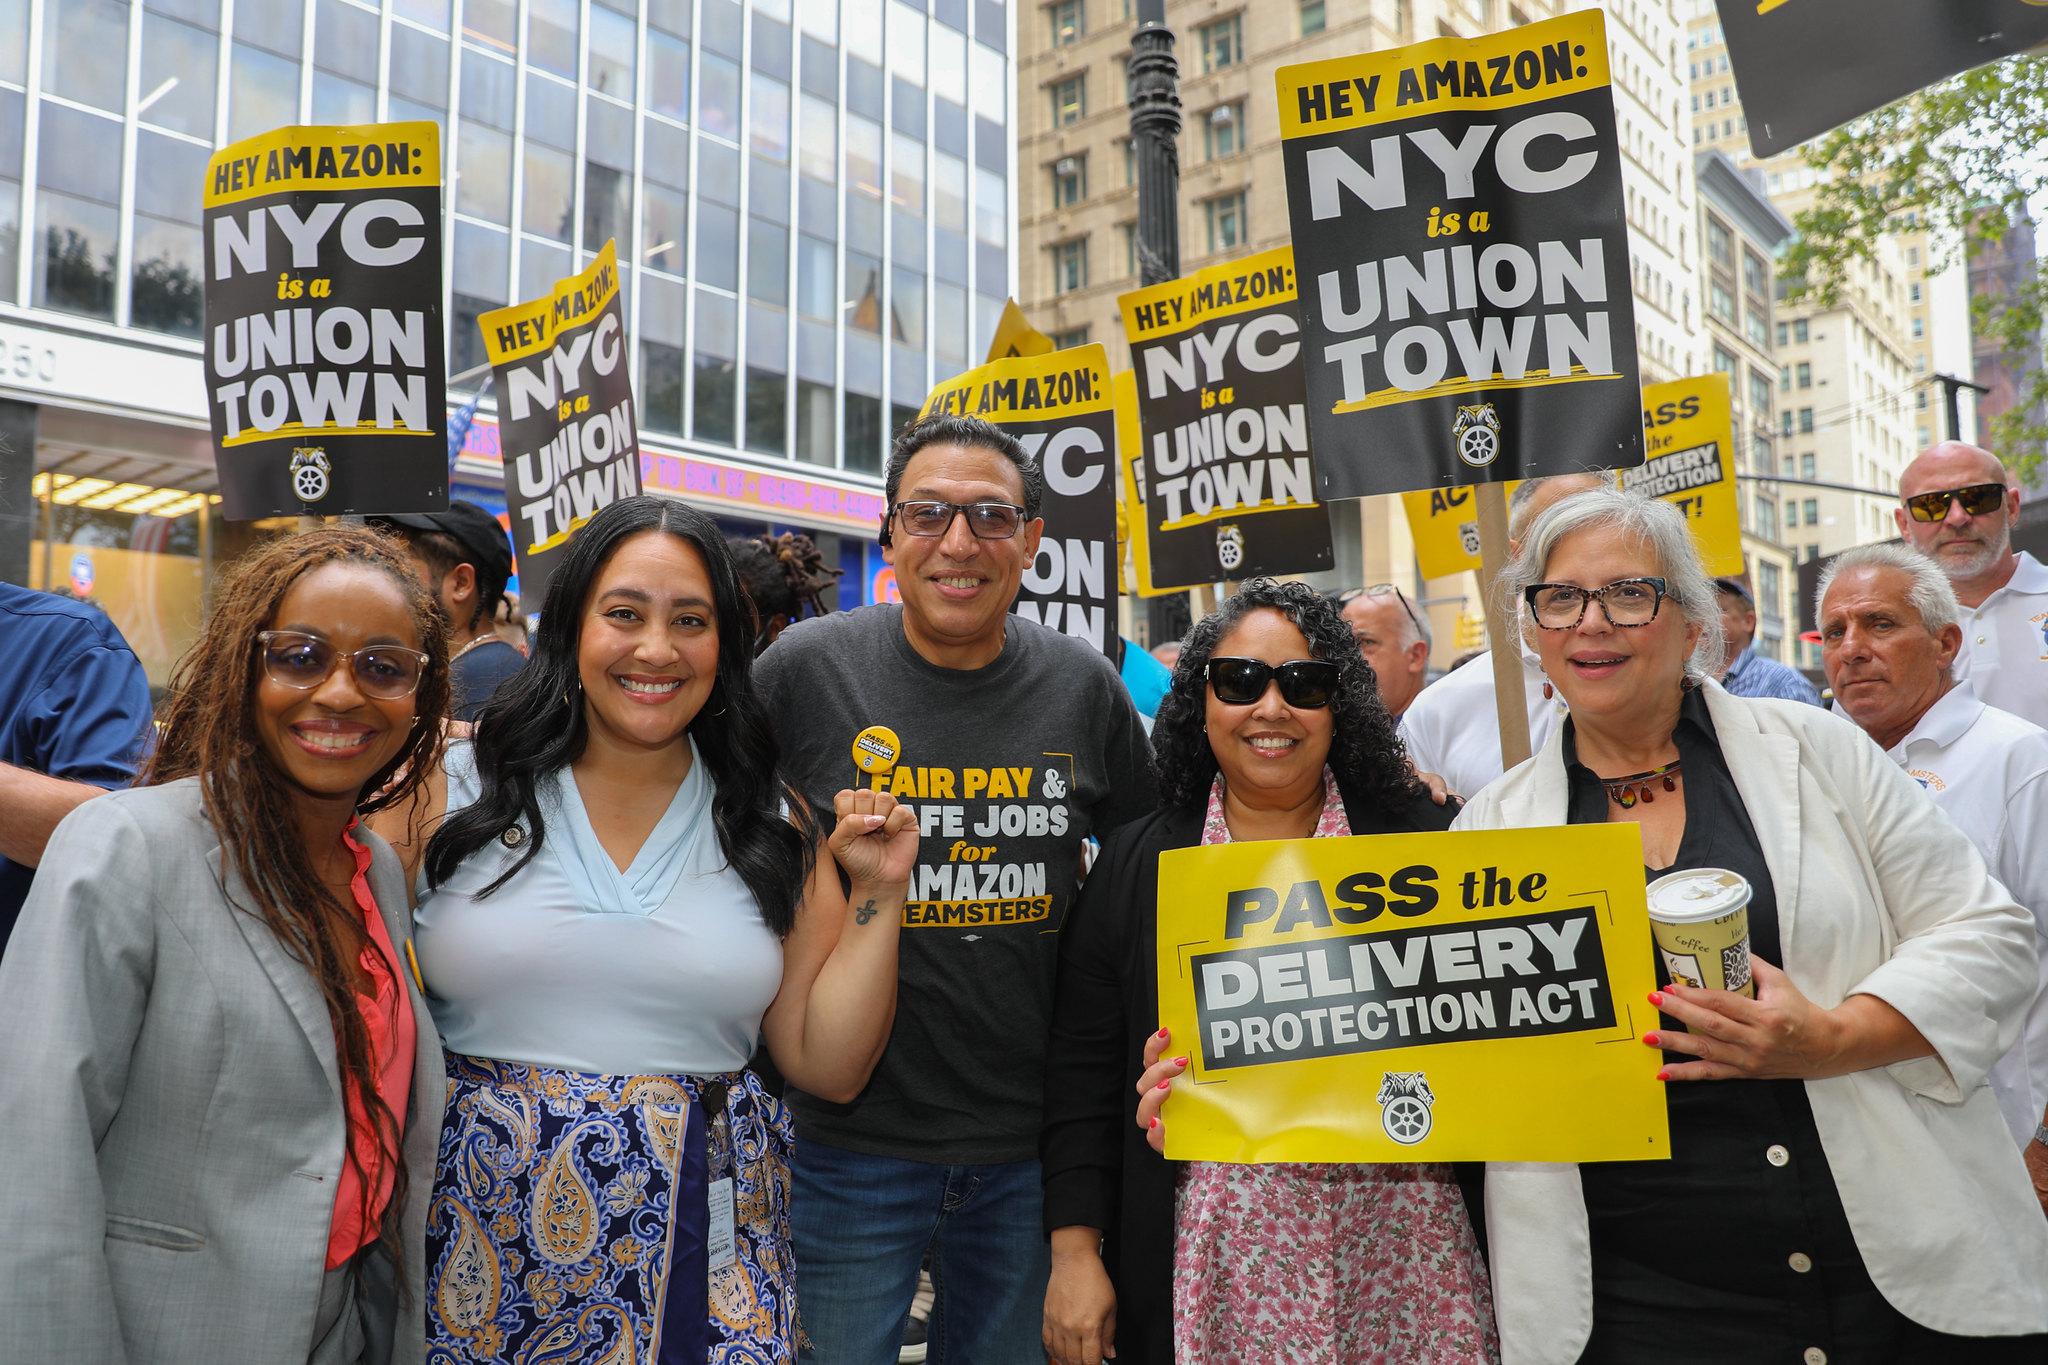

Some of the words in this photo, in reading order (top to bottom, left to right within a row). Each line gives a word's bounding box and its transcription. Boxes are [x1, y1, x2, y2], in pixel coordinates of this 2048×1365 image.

[1297, 75, 1381, 123] HEY
[1396, 40, 1588, 107] AMAZON:
[214, 154, 260, 195] HEY
[265, 142, 423, 184] AMAZON:
[1306, 112, 1598, 221] NYC
[213, 199, 426, 281] NYC
[1426, 207, 1462, 238] is
[1468, 211, 1491, 233] a
[277, 273, 304, 300] is
[309, 278, 332, 299] a
[1134, 299, 1185, 331] HEY
[1190, 266, 1295, 314] AMAZON:
[1317, 238, 1607, 333] UNION
[214, 306, 426, 379] UNION
[496, 314, 546, 353] HEY
[1144, 313, 1301, 399] NYC
[1324, 311, 1613, 404] TOWN
[507, 312, 620, 421] NYC
[929, 387, 973, 416] HEY
[978, 367, 1101, 414] AMAZON:
[216, 371, 428, 439] TOWN
[558, 399, 573, 423] is
[574, 394, 591, 414] a
[1200, 387, 1217, 410] is
[1219, 384, 1235, 404] a
[516, 399, 632, 498] UNION
[1153, 404, 1309, 476] UNION
[1622, 443, 1716, 487] DELIVERY
[520, 452, 637, 547] TOWN
[657, 457, 681, 488] TO
[1156, 457, 1313, 524] TOWN
[1633, 462, 1721, 499] OTECTION
[860, 738, 895, 755] DELIVERY
[866, 733, 885, 744] PASS
[870, 766, 956, 799] FAIR
[963, 767, 1033, 799] PAY
[1043, 768, 1067, 799] &
[973, 804, 1069, 837] JOBS
[949, 840, 997, 862] for
[904, 899, 1046, 924] EAMSTERS
[1225, 865, 1439, 940] PASS
[1459, 867, 1548, 910] the
[1201, 917, 1589, 1011] DELIVERY
[1675, 935, 1710, 953] Coffee
[1210, 990, 1496, 1059] PROTECTION
[1508, 978, 1599, 1027] ACT
